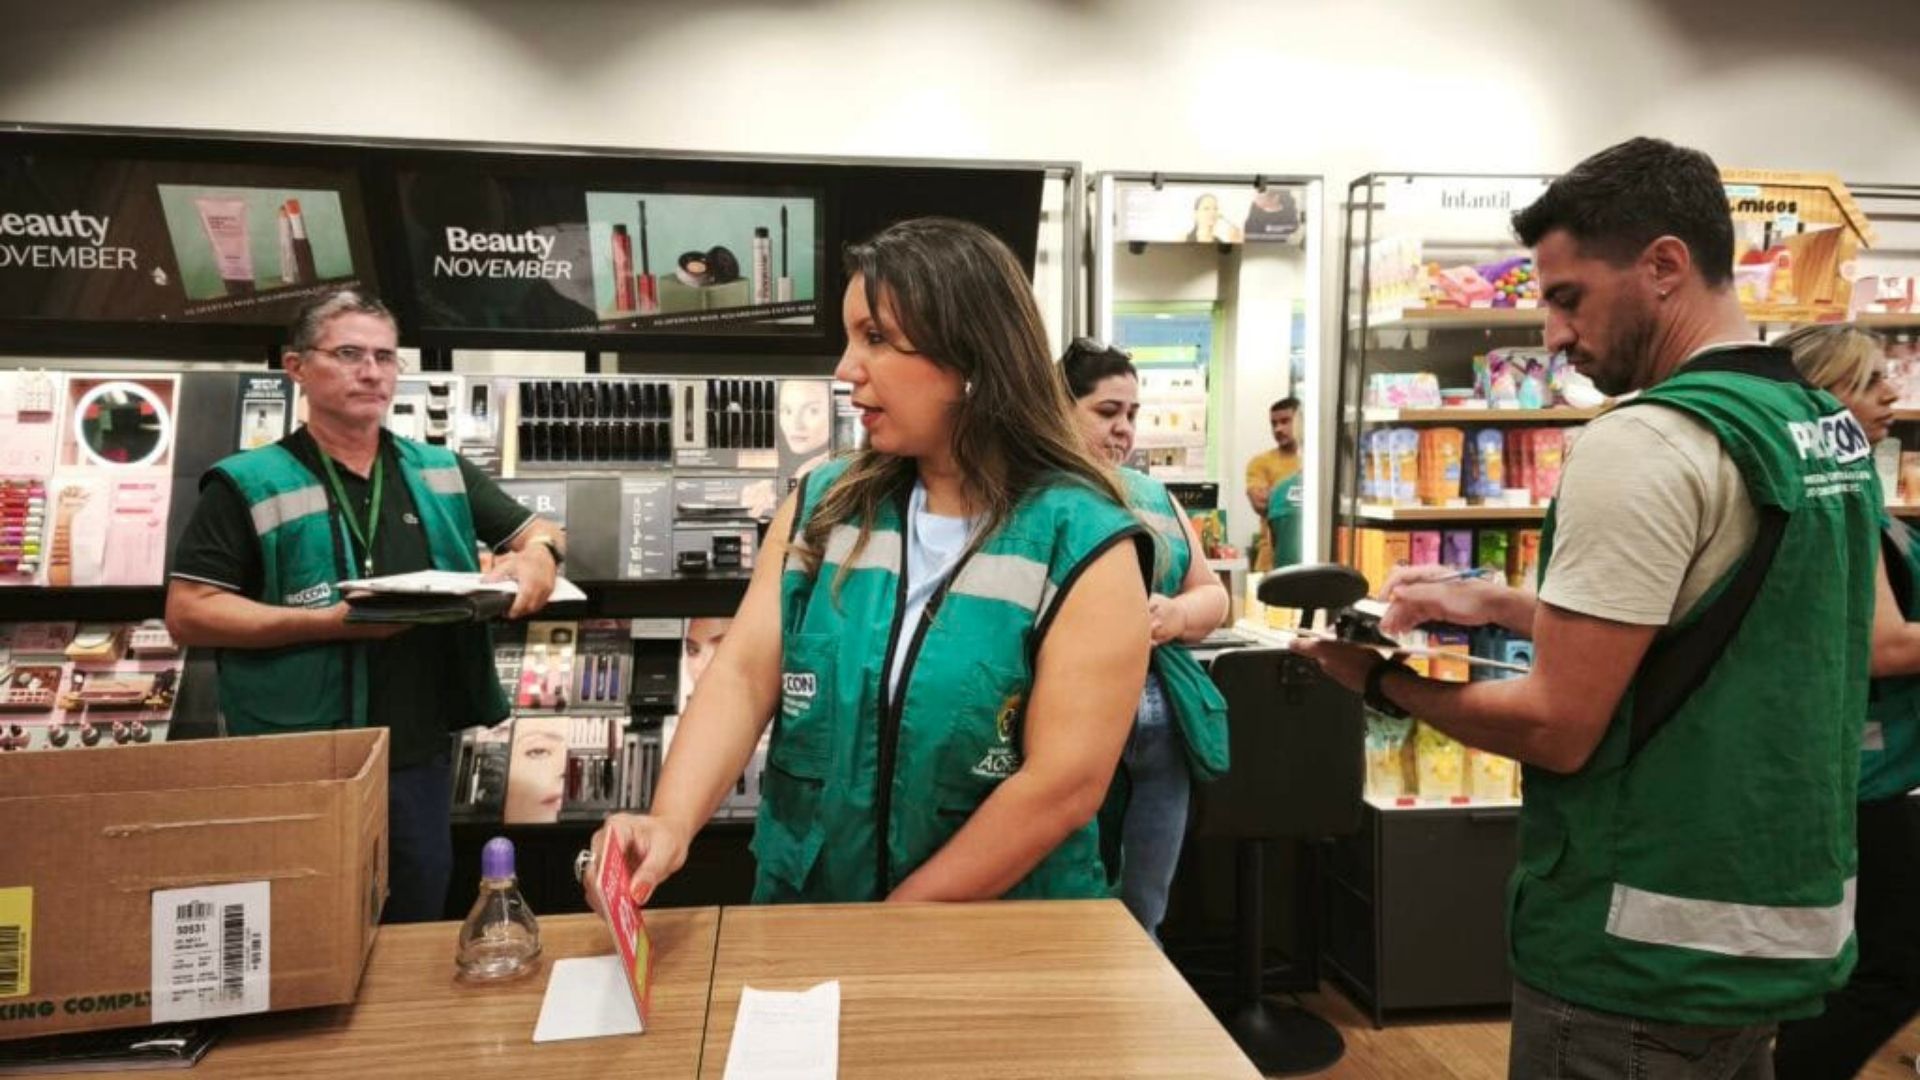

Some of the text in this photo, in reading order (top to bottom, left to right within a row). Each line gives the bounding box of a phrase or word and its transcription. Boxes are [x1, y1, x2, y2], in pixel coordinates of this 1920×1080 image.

[1441, 189, 1511, 209] Infantil
[1730, 199, 1798, 214] MIGOS
[0, 209, 110, 247] eauty
[446, 226, 556, 260] Beauty
[434, 255, 573, 280] NOVEMBER
